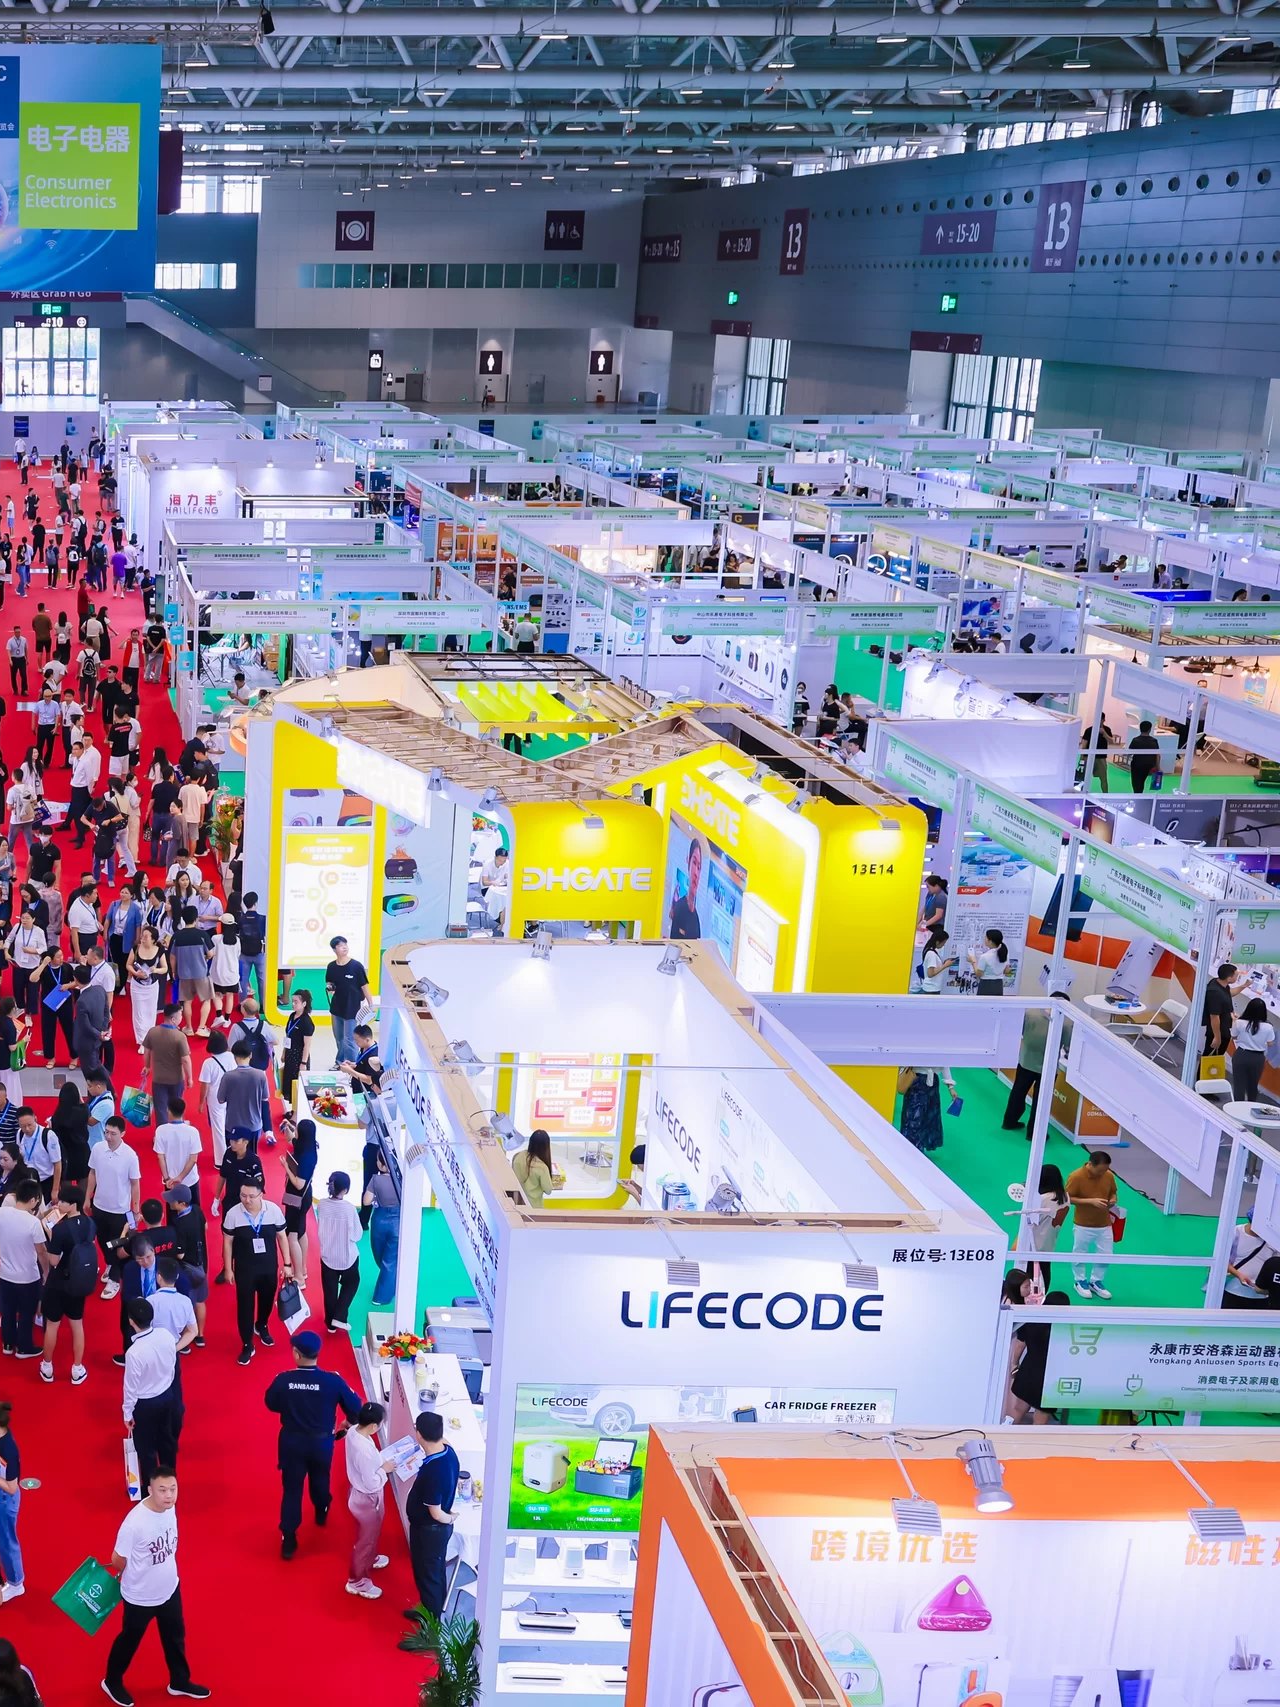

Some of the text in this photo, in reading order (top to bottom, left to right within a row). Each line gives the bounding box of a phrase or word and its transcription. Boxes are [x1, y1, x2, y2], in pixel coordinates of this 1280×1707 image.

[27, 124, 130, 153] 电子电器
[25, 175, 112, 190] Consumer
[25, 193, 117, 209] Electronics
[955, 222, 980, 243] 15-20
[1043, 201, 1072, 250] 13
[737, 237, 752, 253] 15-20
[786, 222, 803, 259] 13
[51, 317, 64, 328] 10
[169, 493, 218, 506] 海力丰
[165, 506, 219, 515] HAILIFENG
[680, 773, 741, 847] DHGATE
[851, 863, 895, 876] 13E14
[521, 866, 653, 892] DHGATE
[1179, 898, 1192, 911] 13F14
[720, 1086, 743, 1121] LIFECODE
[654, 1090, 702, 1174] LIFECODE
[620, 1290, 885, 1332] LIFECODE
[1148, 1357, 1280, 1368] Yongkang Anluosen Sports Eq
[531, 1397, 588, 1407] LIFECODE
[764, 1400, 878, 1412] CAR FRIDGE FREEZER
[834, 1413, 876, 1424] 车载冰箱
[810, 1529, 979, 1564] 跨境优选
